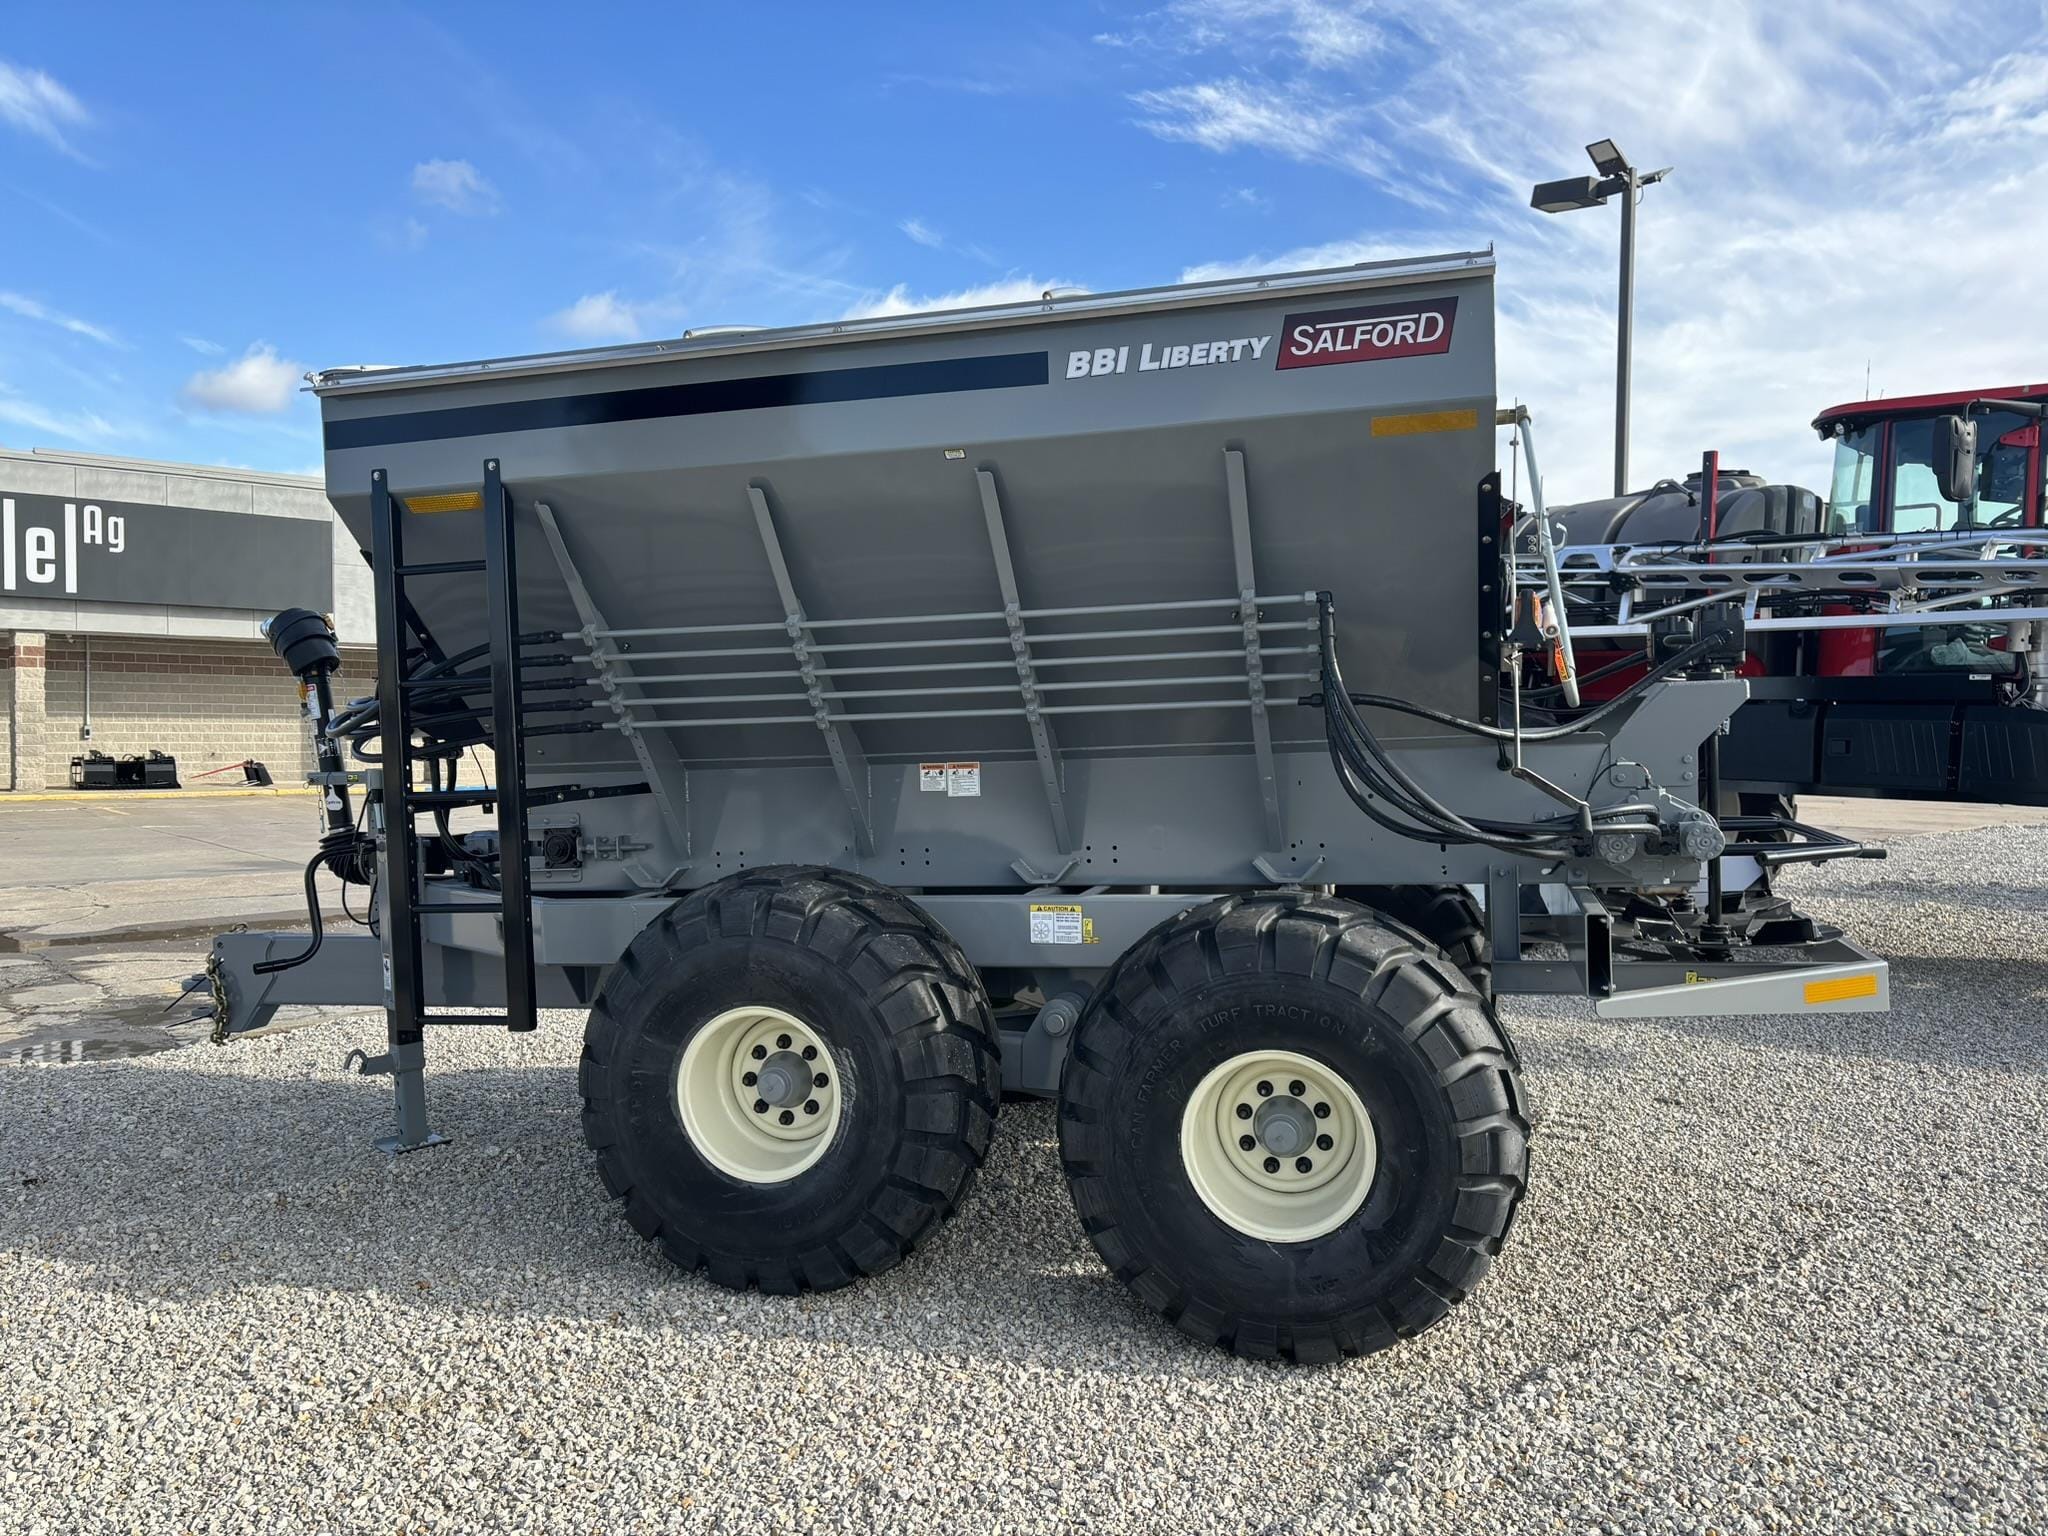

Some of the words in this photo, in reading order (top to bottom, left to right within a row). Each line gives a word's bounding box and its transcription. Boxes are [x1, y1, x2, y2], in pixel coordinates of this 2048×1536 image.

[1290, 311, 1445, 356] SALFORD
[1065, 346, 1130, 379] BBI
[1137, 335, 1273, 372] LIBERTY
[83, 505, 125, 553] Ag
[1138, 1040, 1184, 1103] FARMER
[1198, 1008, 1241, 1033] TURF
[1252, 1004, 1346, 1036] TRACTION
